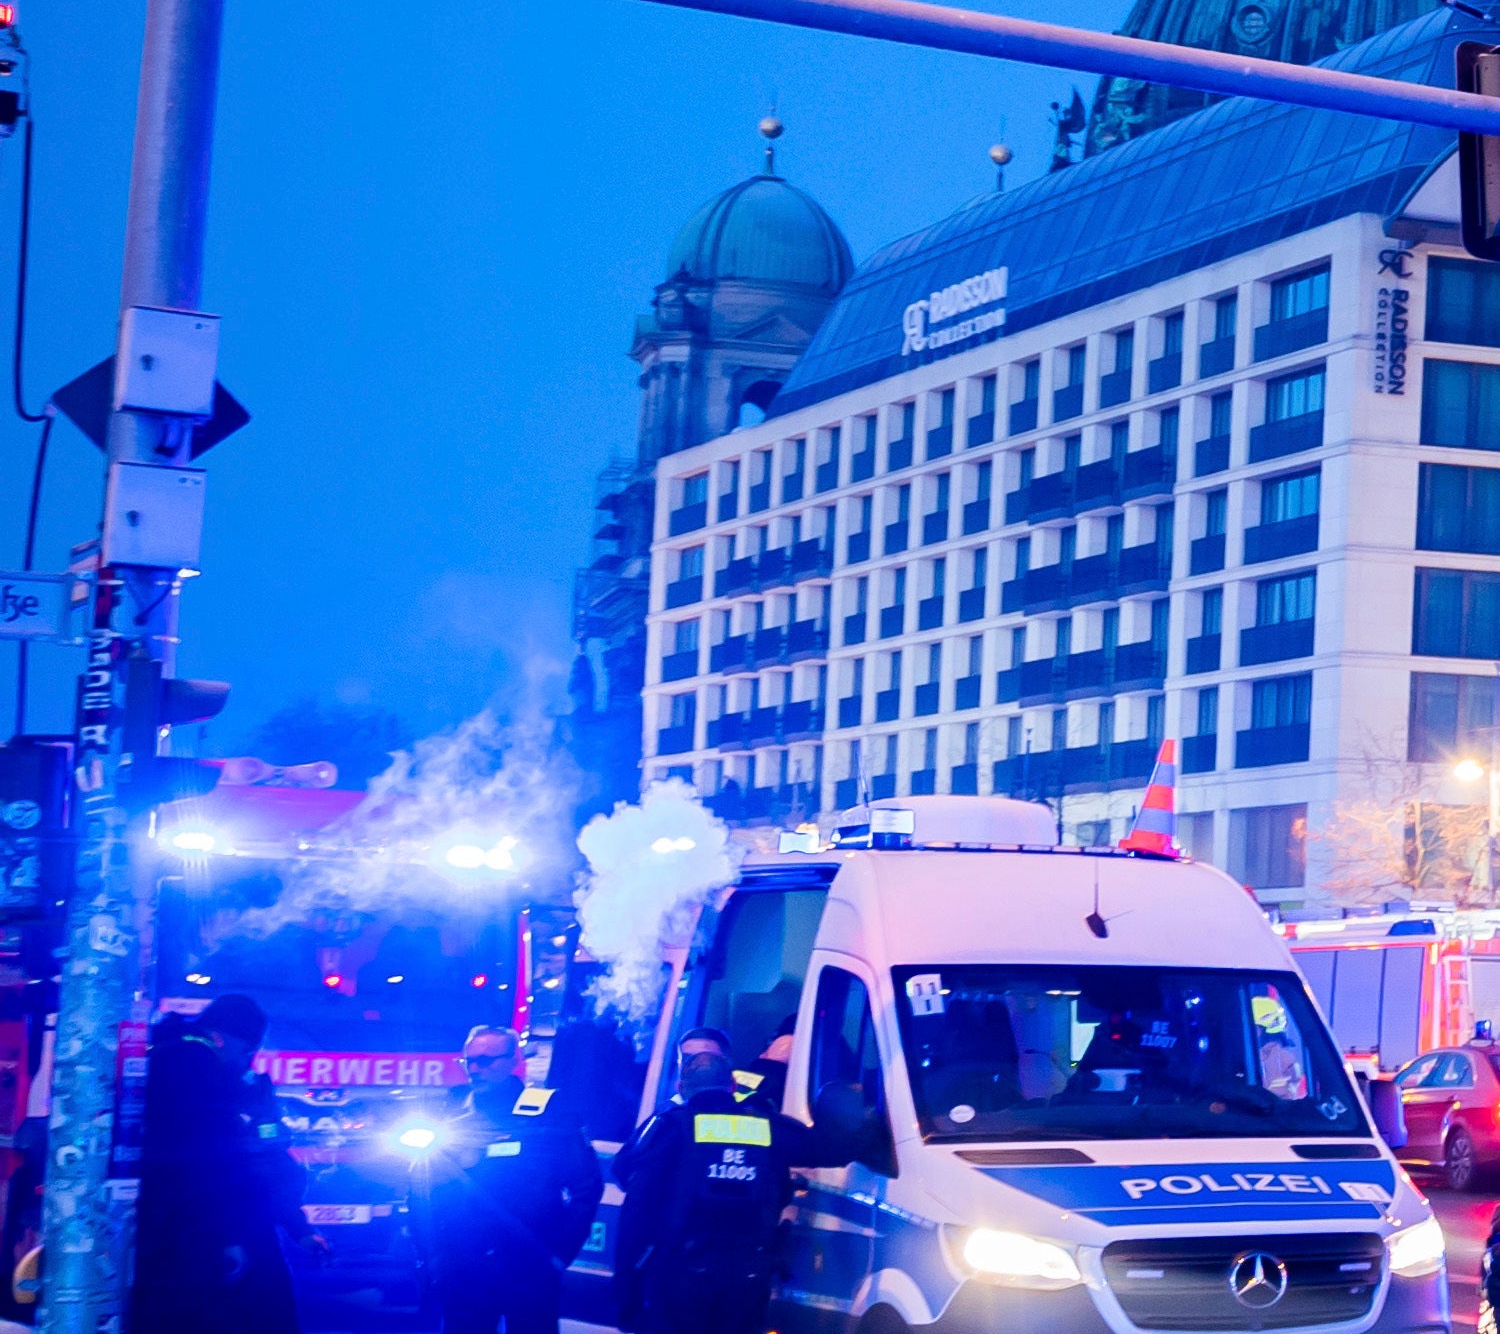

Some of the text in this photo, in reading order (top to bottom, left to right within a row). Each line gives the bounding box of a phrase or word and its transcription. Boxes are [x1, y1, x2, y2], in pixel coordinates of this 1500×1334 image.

[1387, 288, 1409, 396] RADISSON
[256, 1057, 445, 1086] UERWEHR
[722, 1148, 746, 1165] BE
[1120, 1174, 1332, 1199] POLIZEI
